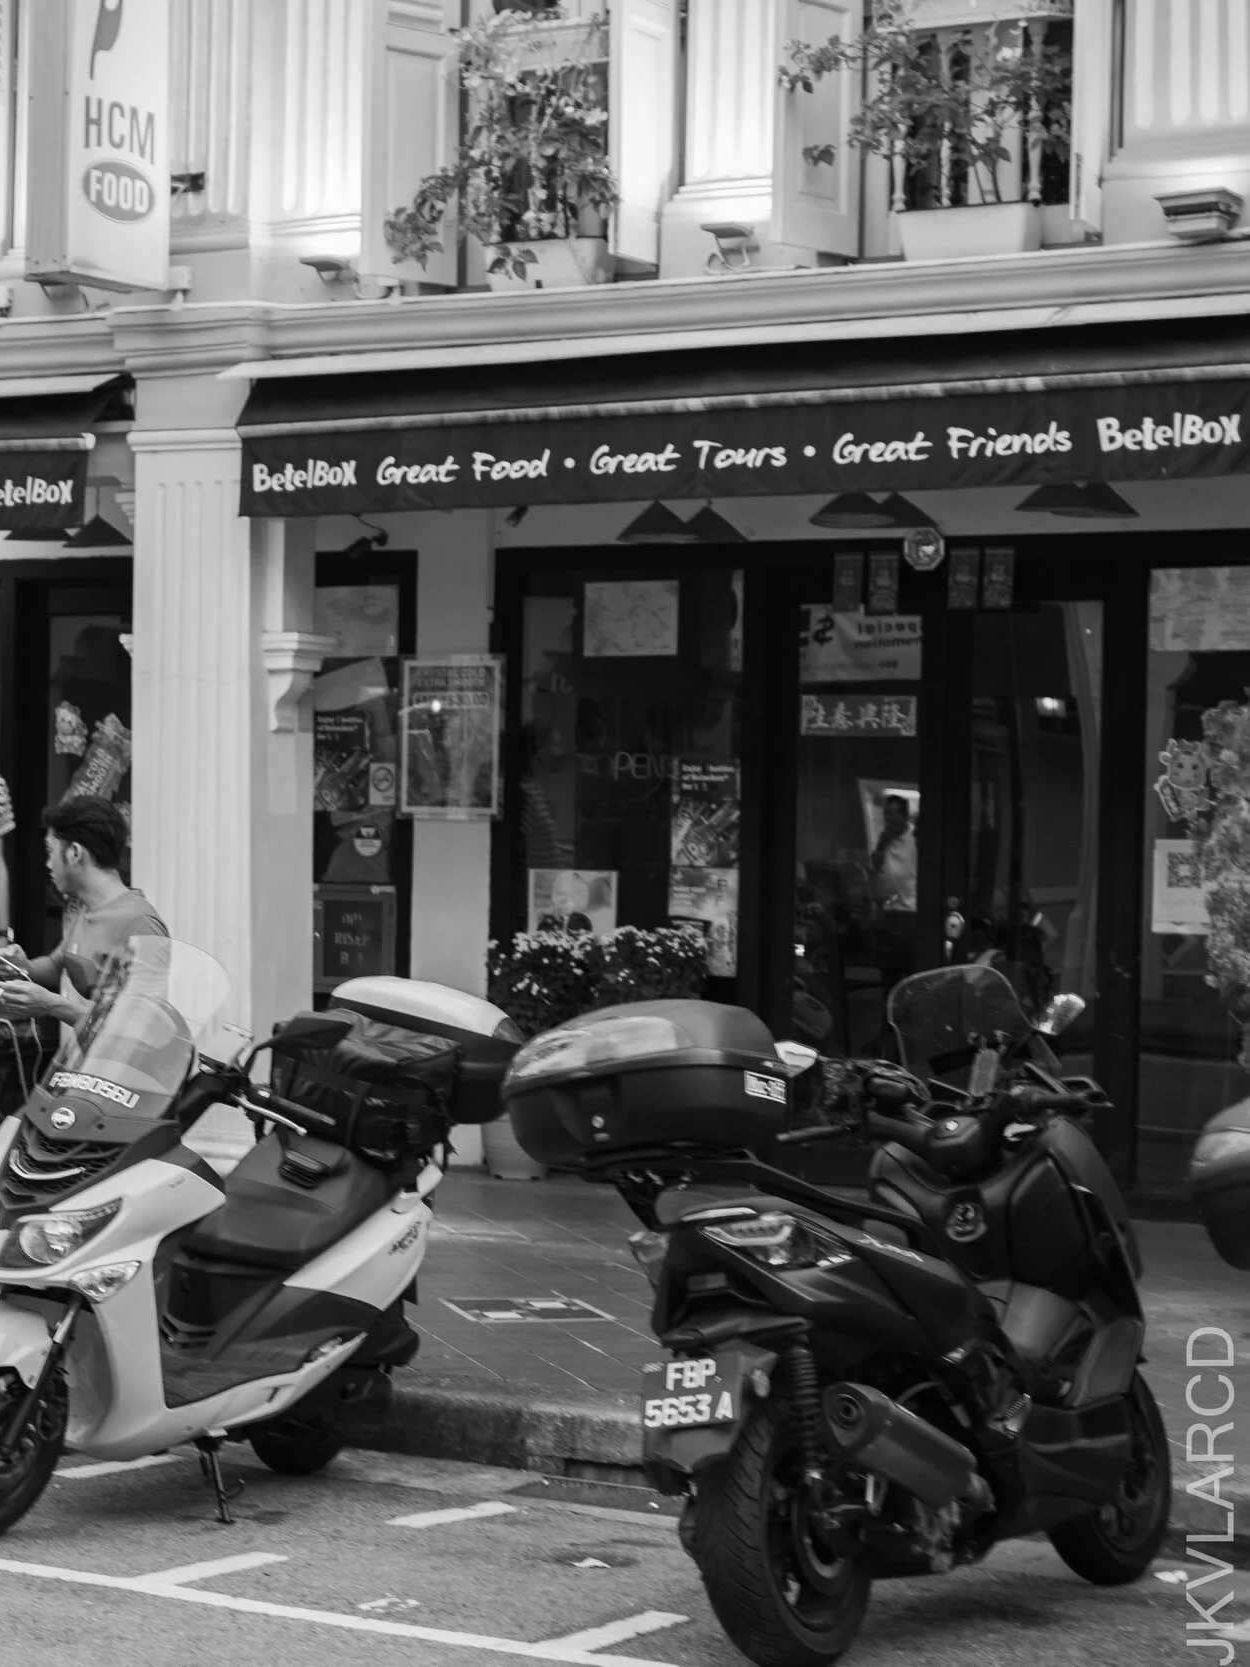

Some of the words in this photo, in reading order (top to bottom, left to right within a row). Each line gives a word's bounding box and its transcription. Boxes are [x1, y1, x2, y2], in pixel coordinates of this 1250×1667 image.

[85, 95, 155, 166] HCM
[89, 168, 150, 214] FOOD
[376, 455, 461, 486] Great
[471, 448, 551, 481] Food
[589, 444, 682, 475] Great
[692, 439, 788, 470] Tours
[832, 432, 934, 465] Great
[946, 420, 1073, 459] Friends
[665, 1358, 717, 1391] FBP
[715, 1391, 734, 1420] A
